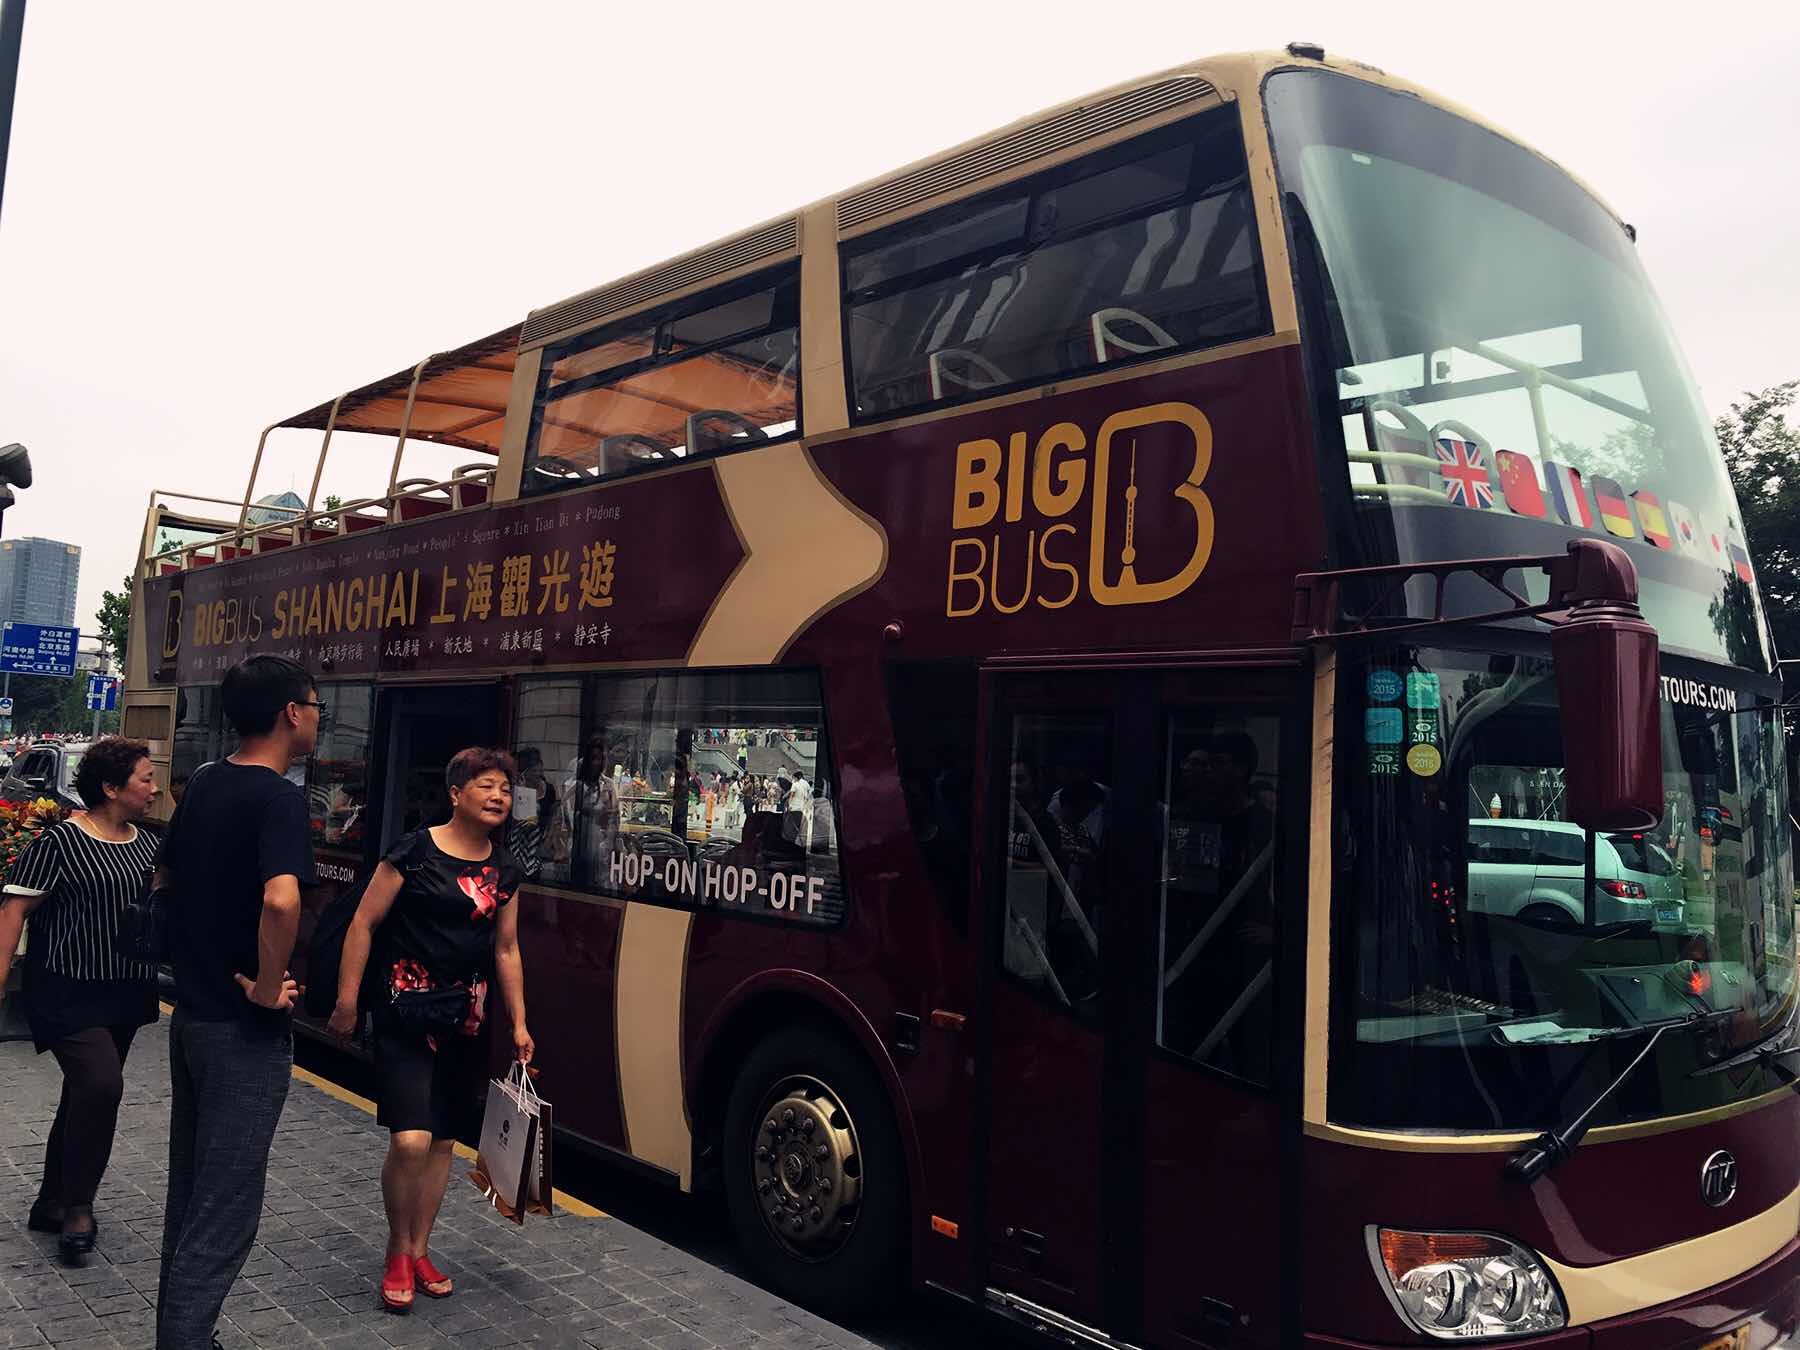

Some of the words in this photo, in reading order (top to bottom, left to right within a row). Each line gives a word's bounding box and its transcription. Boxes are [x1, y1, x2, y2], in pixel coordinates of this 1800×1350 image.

[953, 422, 1087, 529] BIG
[472, 529, 501, 544] Square
[514, 519, 529, 536] Xin
[535, 516, 554, 532] Tian
[585, 504, 621, 522] Pudong
[271, 566, 419, 640] SHANGHAI
[430, 538, 617, 624] 上海觀光遊
[947, 523, 1079, 618] BUS
[444, 635, 473, 655] 新天地
[1659, 676, 1737, 712] TOURS.COM
[1412, 732, 1437, 742] 2015
[1370, 763, 1399, 774] 2015
[609, 851, 698, 896] HOP-ON
[705, 862, 825, 914] HOP-OFF
